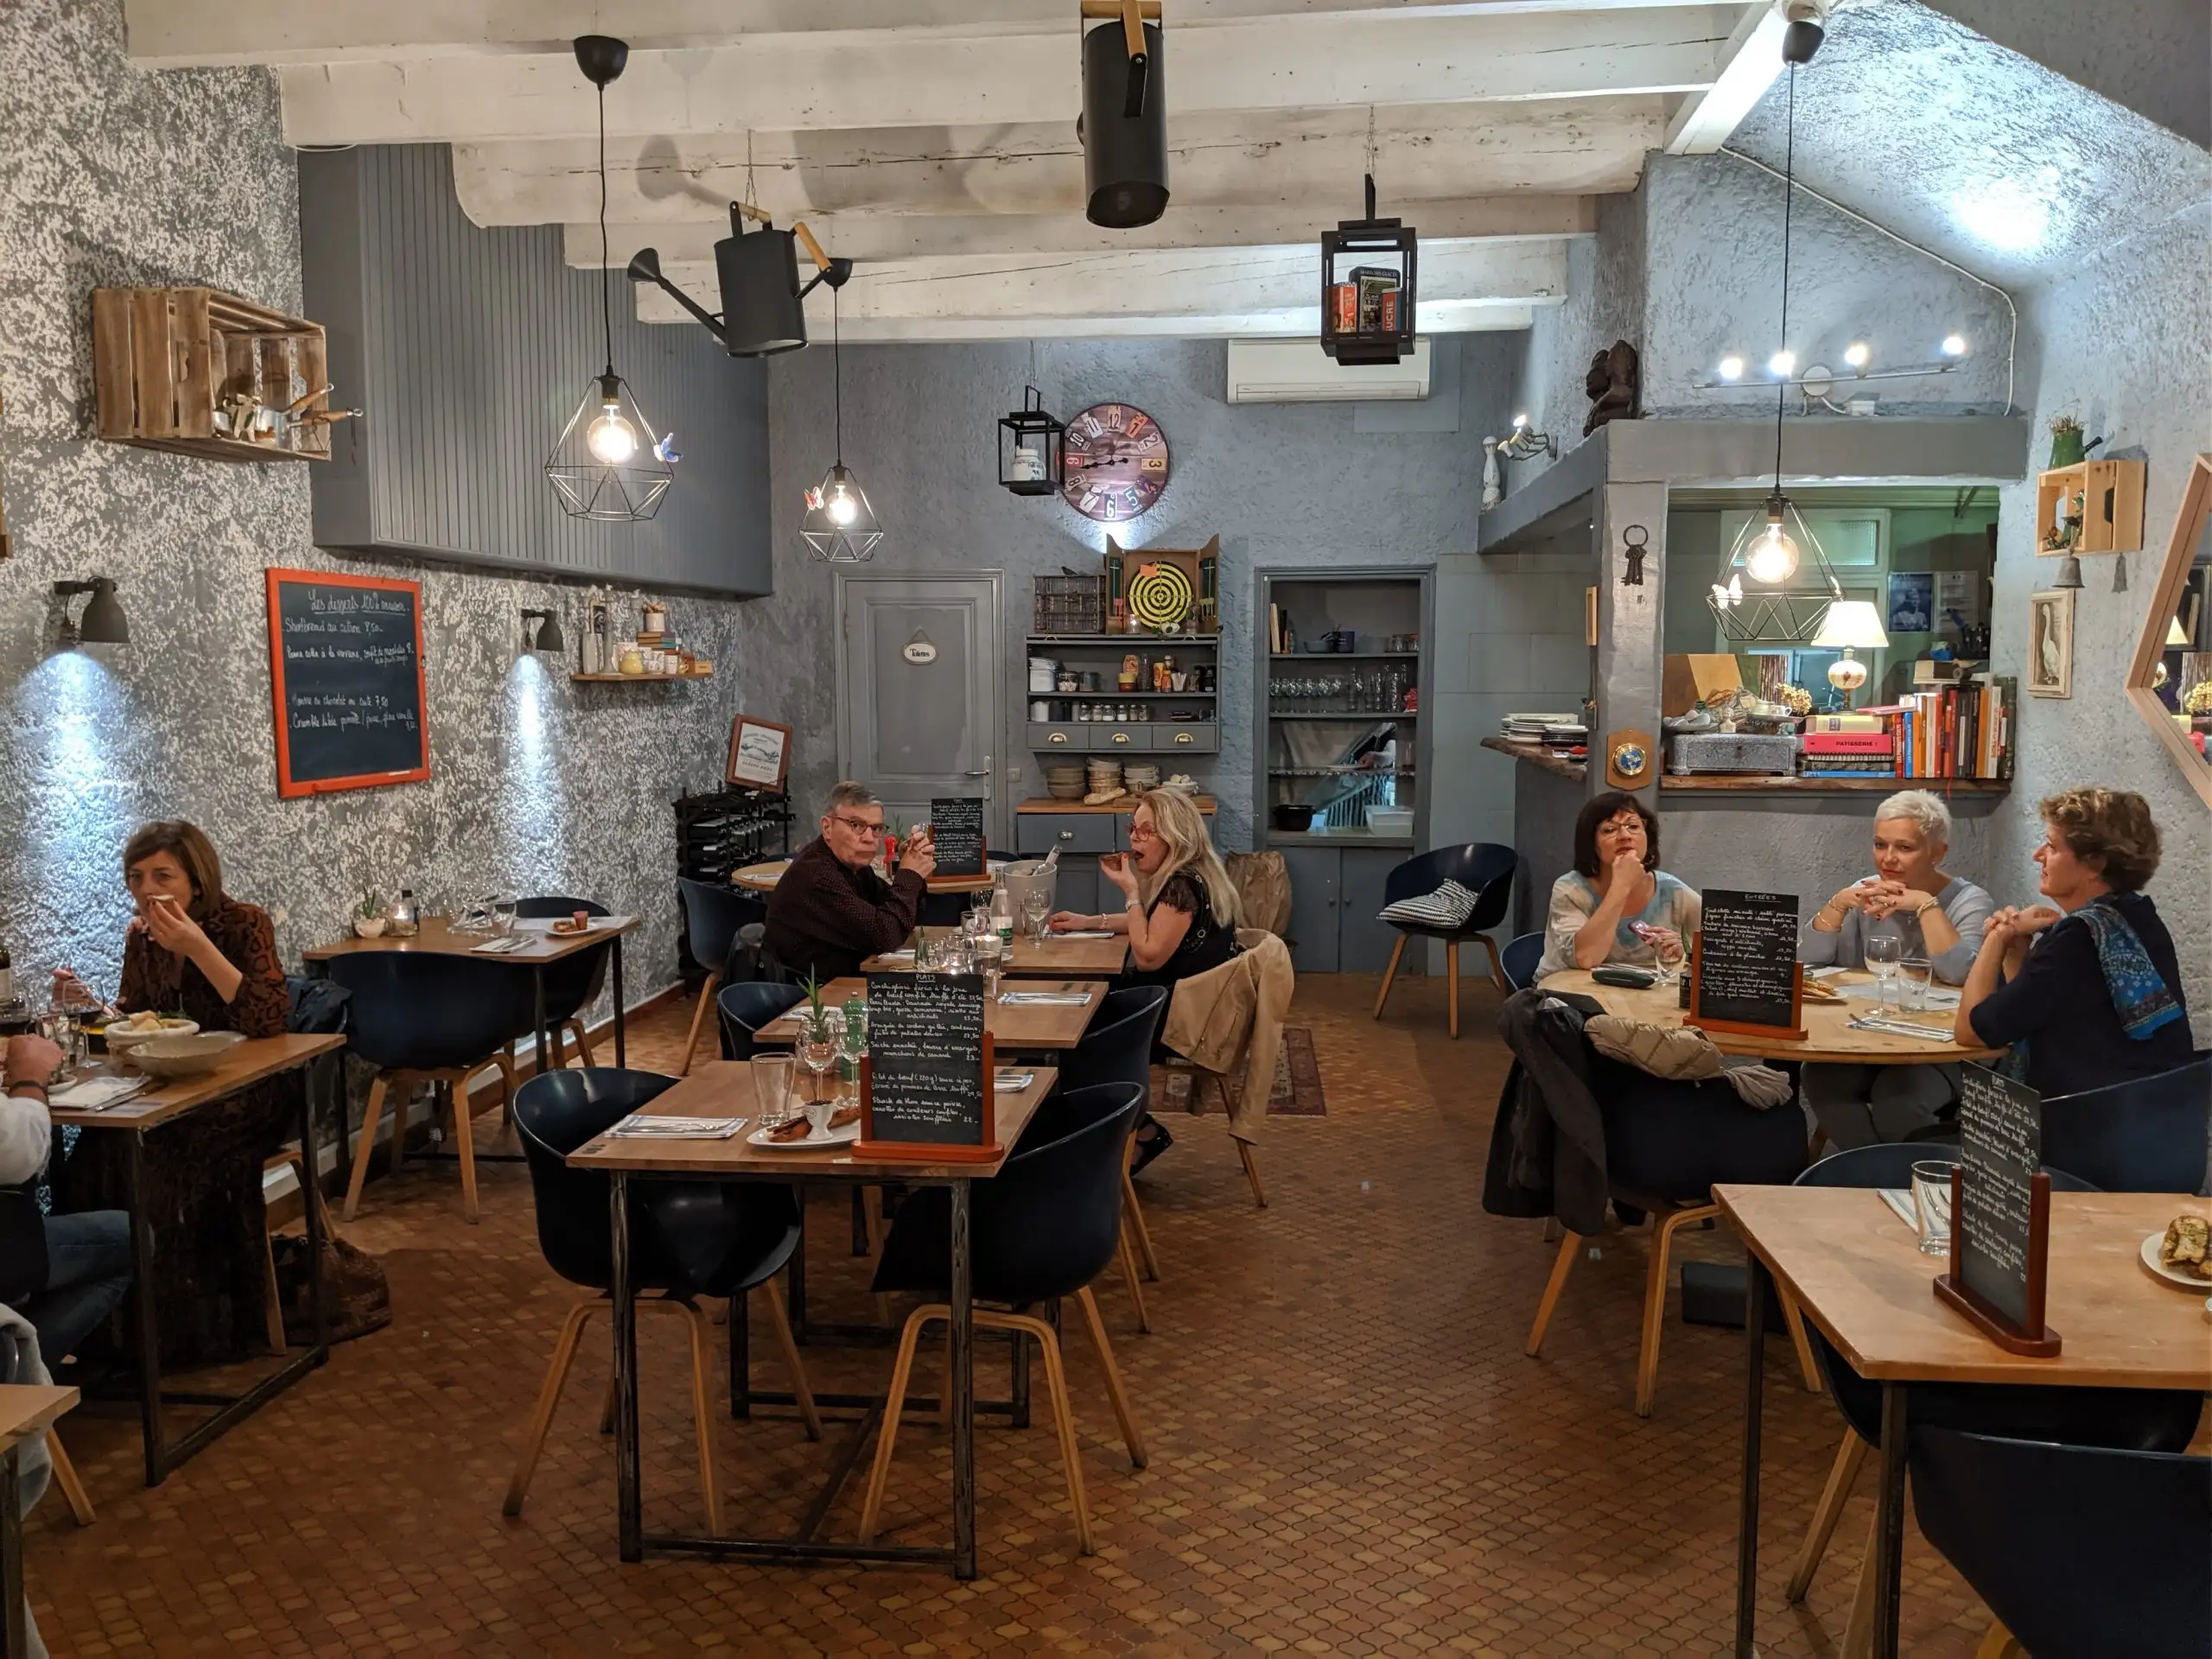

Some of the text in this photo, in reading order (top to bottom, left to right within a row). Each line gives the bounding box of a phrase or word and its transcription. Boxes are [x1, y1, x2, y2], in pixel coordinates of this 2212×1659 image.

[1109, 414, 1120, 429] 12
[1070, 432, 1085, 447] 10
[1143, 434, 1159, 447] 2
[1148, 460, 1162, 468] 3
[1125, 490, 1138, 506] 5
[1107, 499, 1115, 518] 6
